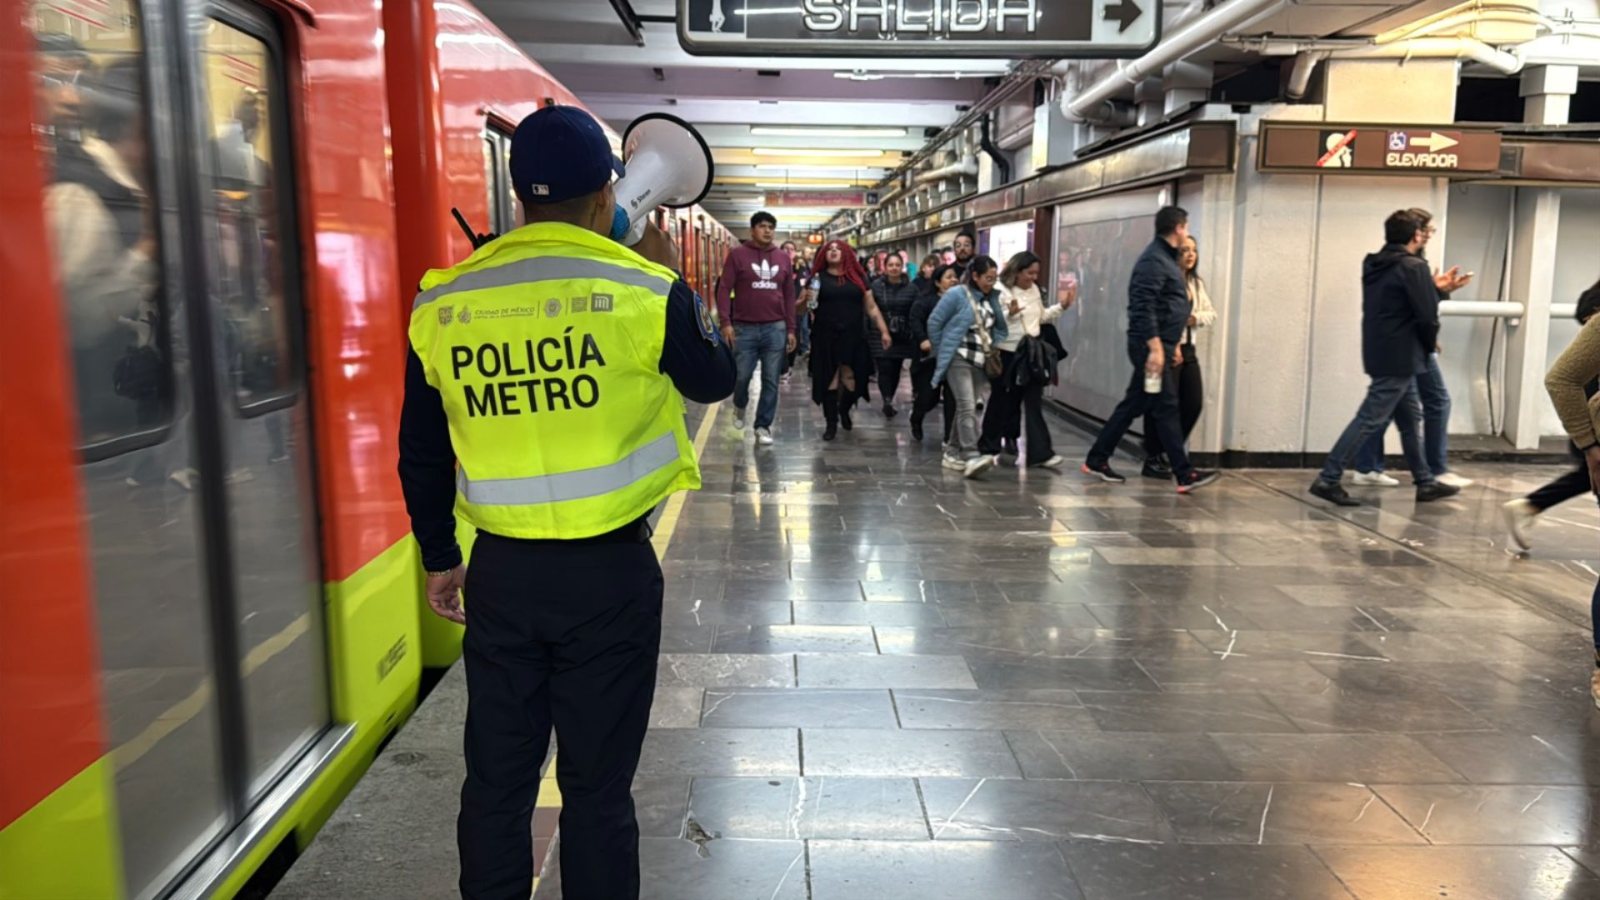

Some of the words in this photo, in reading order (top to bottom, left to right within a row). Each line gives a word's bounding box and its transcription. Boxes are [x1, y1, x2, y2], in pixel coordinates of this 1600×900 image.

[803, 0, 1036, 32] SALIDA
[1386, 152, 1458, 168] ELEVADOR
[751, 280, 778, 290] adidas
[451, 326, 606, 380] POLICÍA
[463, 374, 600, 418] METRO
